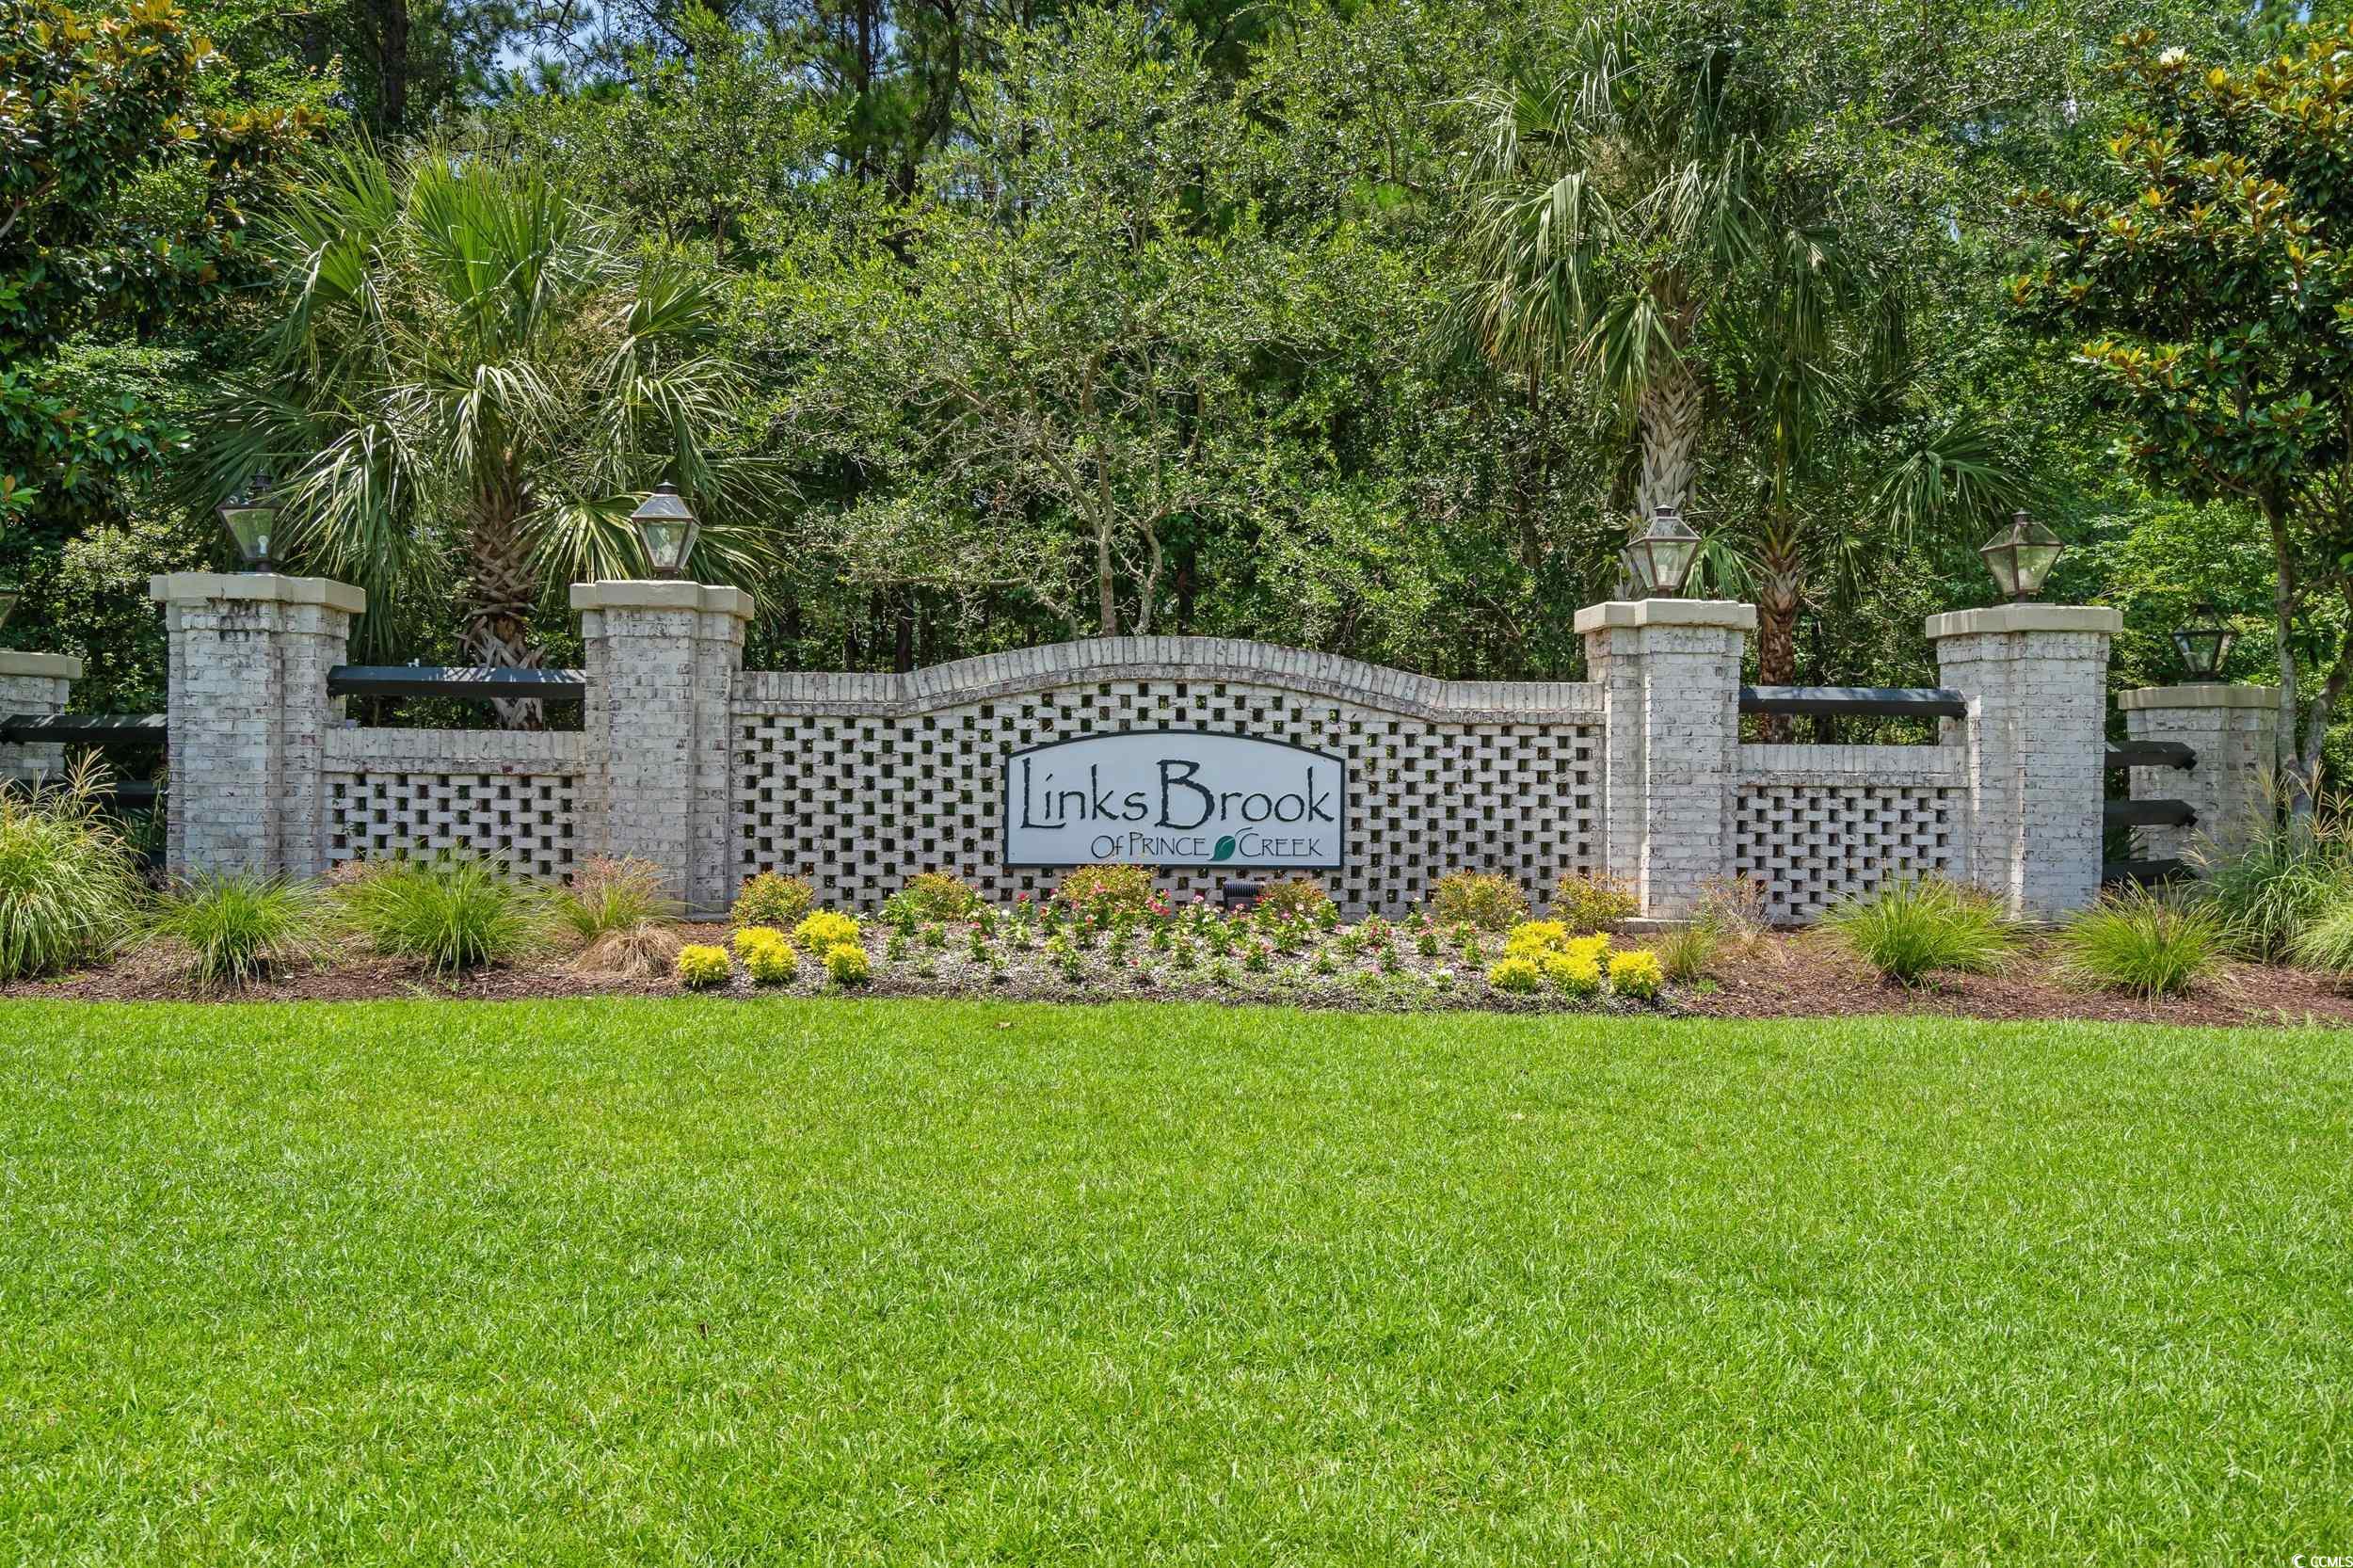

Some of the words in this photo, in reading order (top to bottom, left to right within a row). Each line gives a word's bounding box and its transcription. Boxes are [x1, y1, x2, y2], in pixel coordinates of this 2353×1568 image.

[1020, 757, 1148, 829] Links
[1155, 760, 1335, 830] Brook
[1128, 831, 1209, 857] PRINCE
[1239, 832, 1323, 857] CREEK
